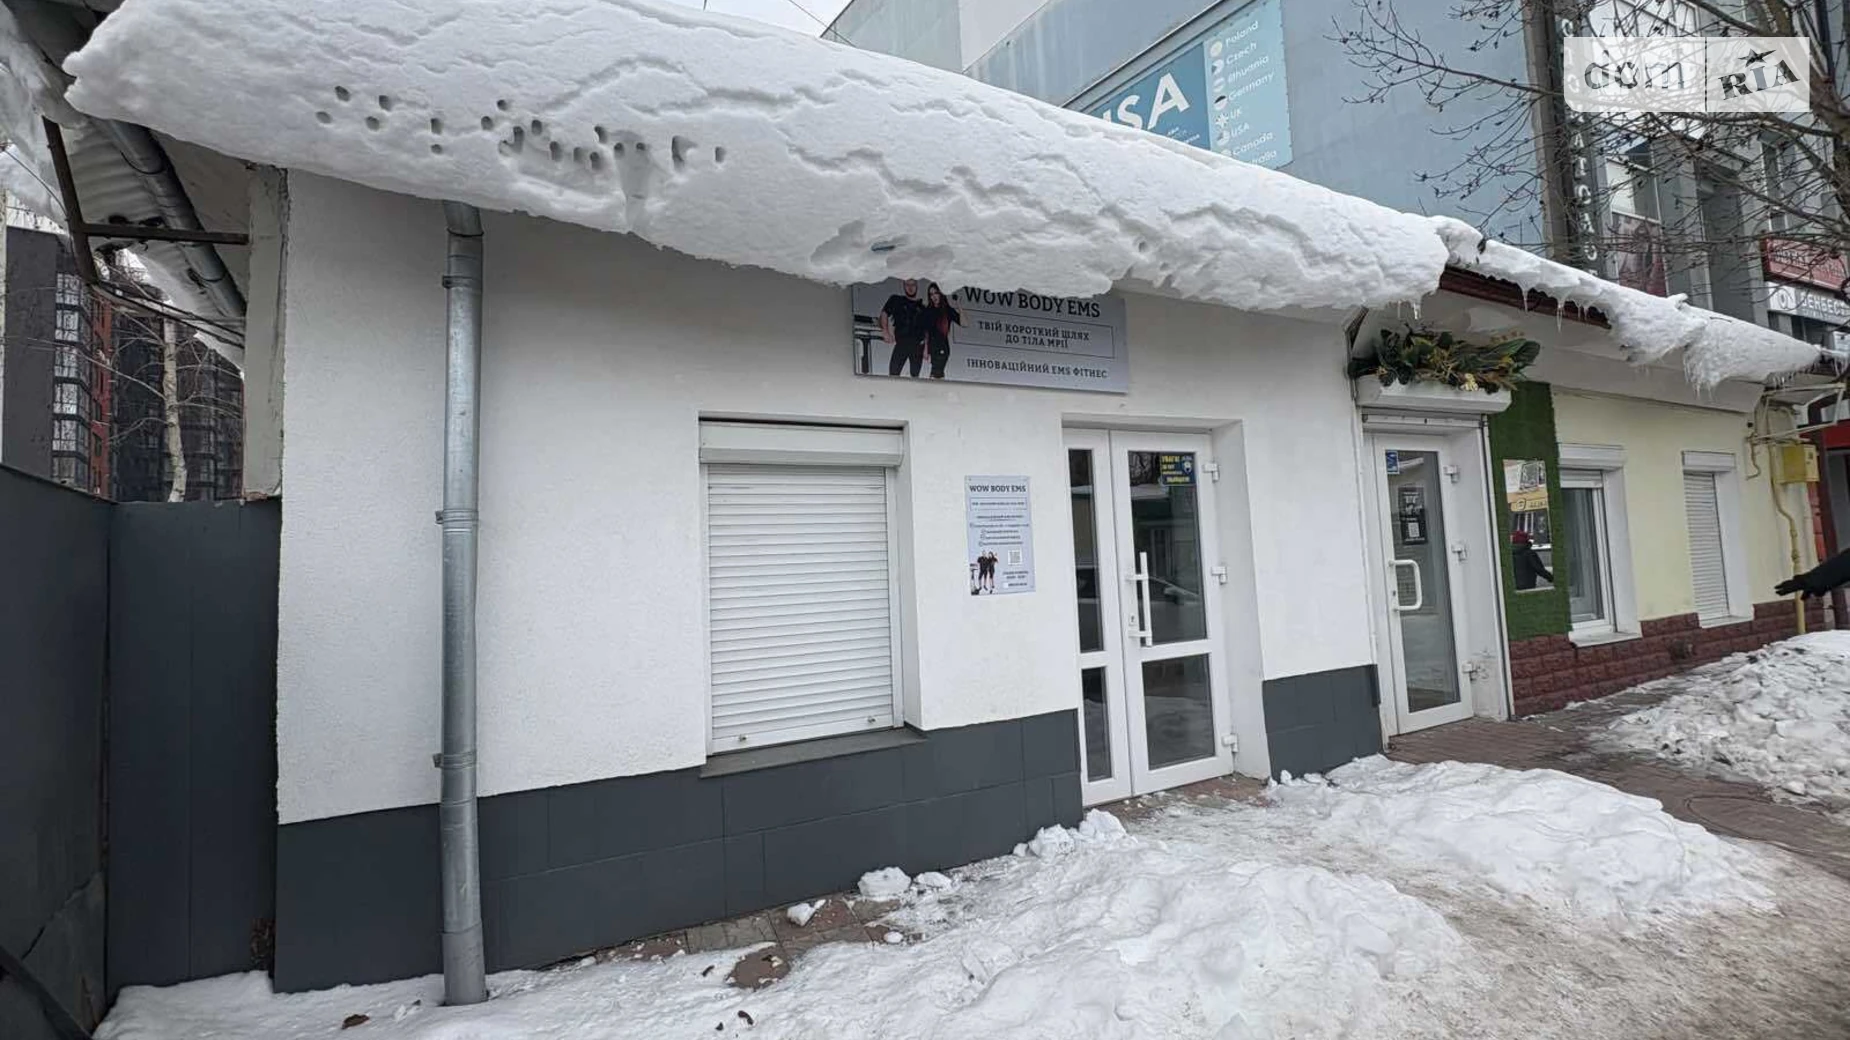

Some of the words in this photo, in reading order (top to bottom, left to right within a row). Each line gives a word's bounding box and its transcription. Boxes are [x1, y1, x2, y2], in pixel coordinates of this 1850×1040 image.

[1102, 72, 1189, 131] SA
[964, 286, 1014, 307] WOW
[1018, 293, 1065, 313] BODY
[1068, 299, 1101, 318] EMS
[978, 320, 1003, 333] ТВІЙ
[1005, 324, 1060, 338] КОРОТКИЙ
[1061, 330, 1091, 341] ШЛЯХ
[1005, 334, 1020, 345] ДО
[1022, 336, 1045, 347] ТІЛА
[966, 358, 1050, 375] ІННОВАЦІЙНИЙ
[1072, 367, 1108, 379] ФІТНЕС
